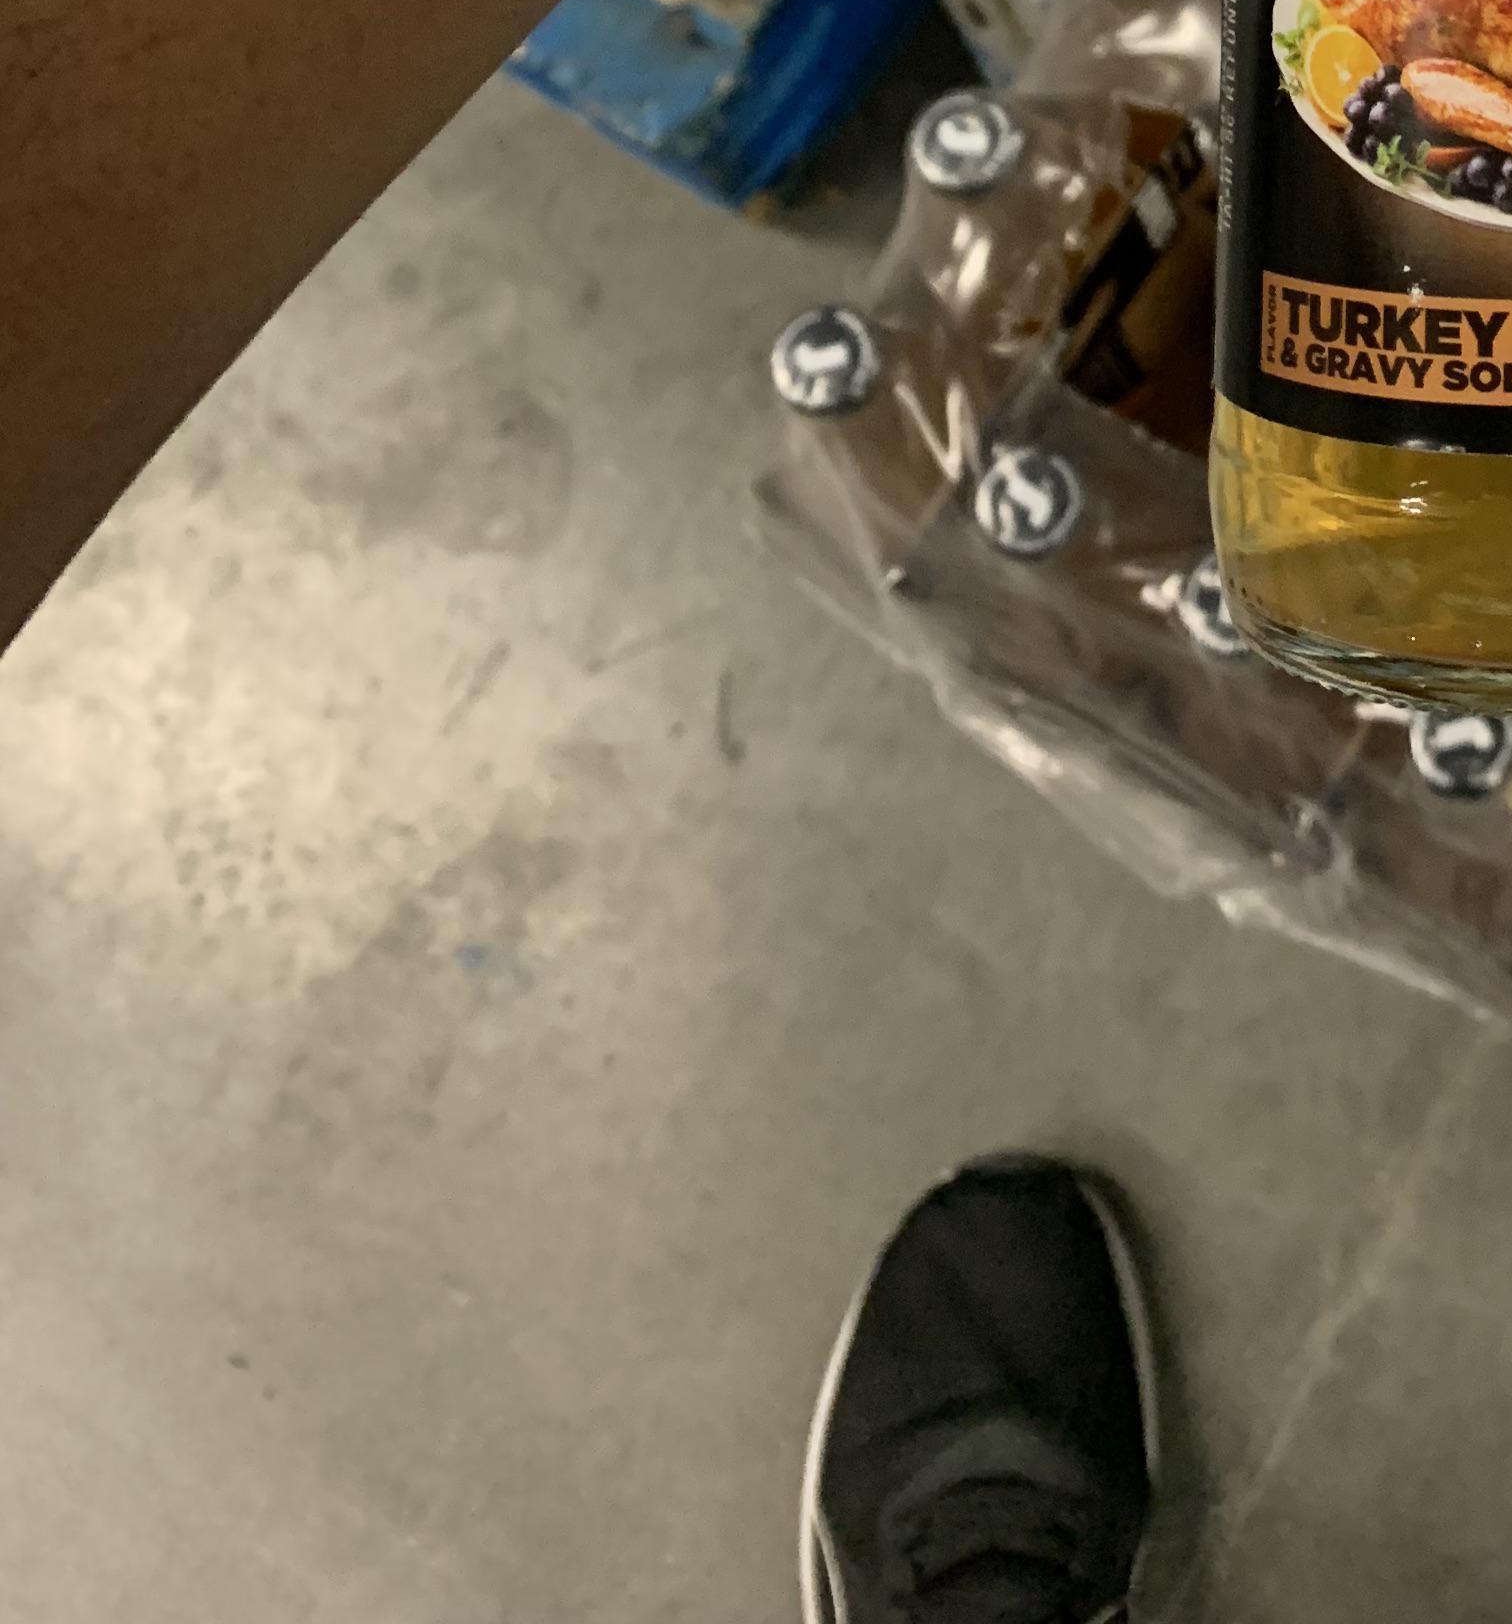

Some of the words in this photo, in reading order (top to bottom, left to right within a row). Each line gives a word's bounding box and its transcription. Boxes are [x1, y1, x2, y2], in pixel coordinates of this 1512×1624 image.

[1266, 284, 1277, 364] FLAVOR
[1281, 286, 1510, 359] TURKEY
[1280, 336, 1299, 368] &
[1304, 342, 1434, 390] GRAVY
